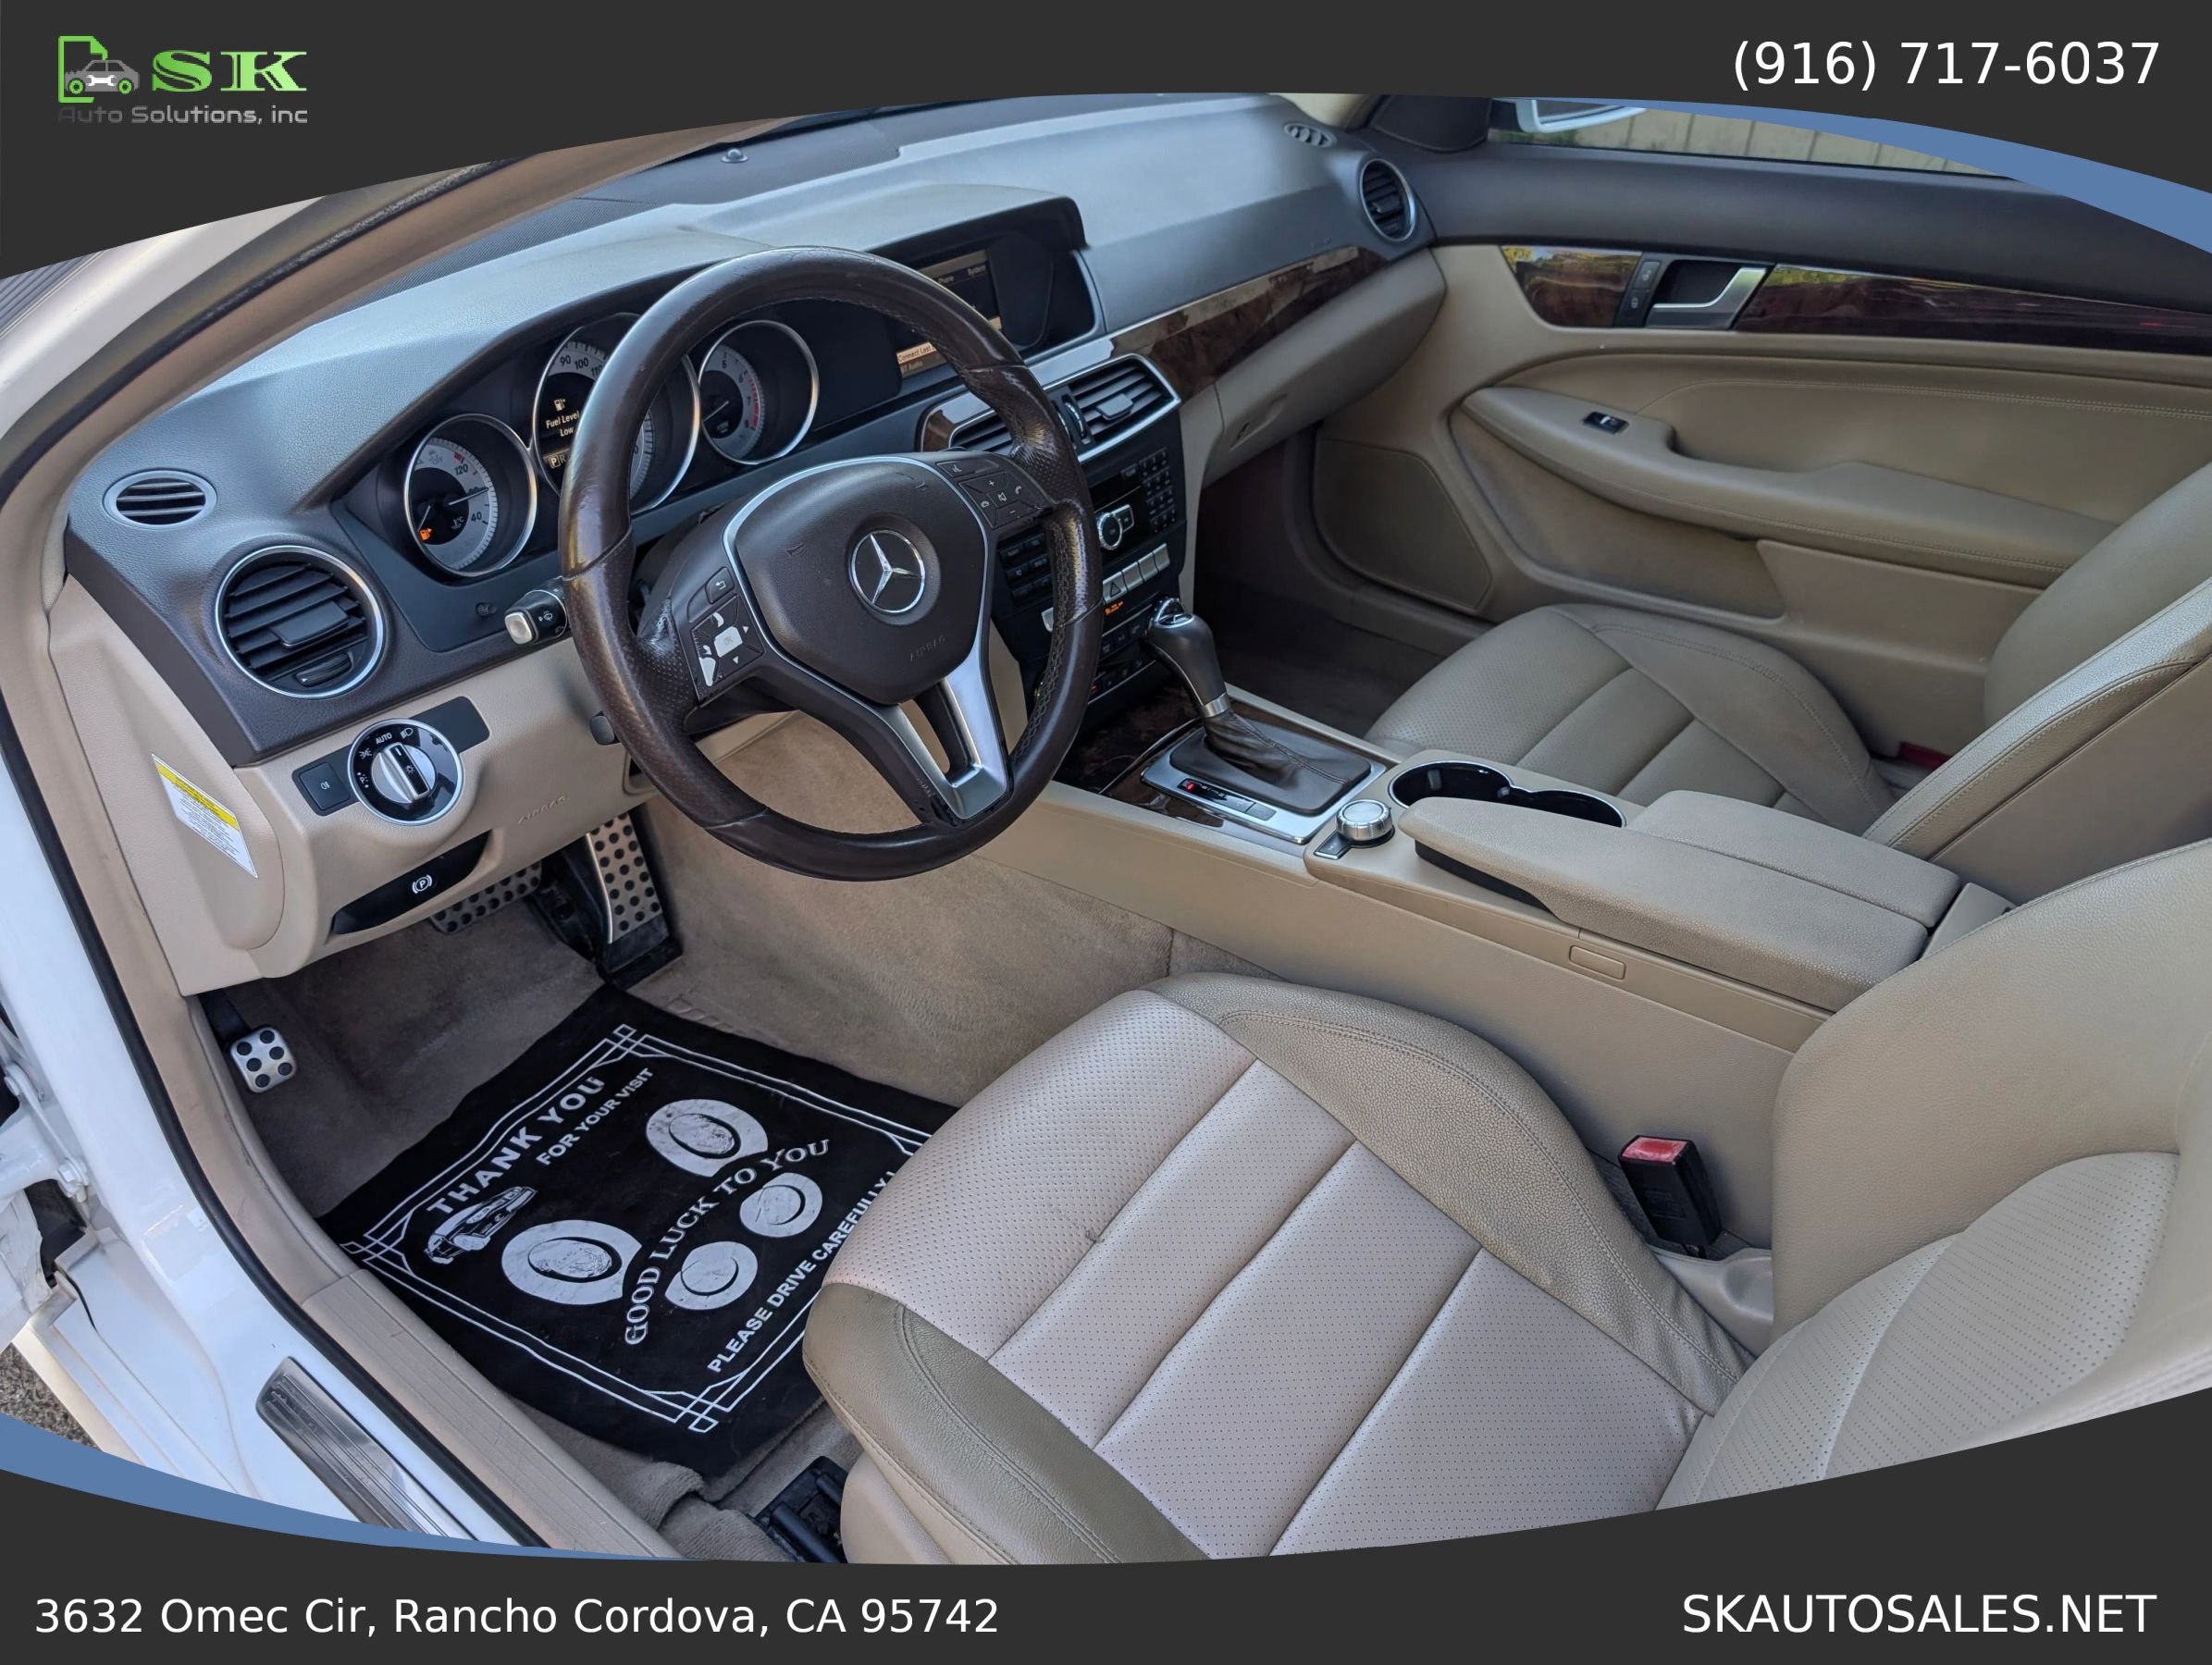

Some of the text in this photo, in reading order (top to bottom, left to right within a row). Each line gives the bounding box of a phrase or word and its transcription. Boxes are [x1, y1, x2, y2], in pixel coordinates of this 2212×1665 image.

[560, 354, 571, 366] 90
[575, 357, 589, 370] 100
[546, 410, 580, 428] Fuel Level
[560, 426, 574, 437] Low
[454, 463, 469, 475] 120
[471, 511, 483, 523] 40
[376, 732, 392, 744] AUTO
[536, 1067, 653, 1166] FOR YOUR VISIT
[426, 1076, 605, 1215] THANK YOU
[624, 1139, 830, 1345] GOOD LUCK TO YOU
[707, 1306, 773, 1373] PLEASE
[767, 1259, 817, 1308] DRIVE
